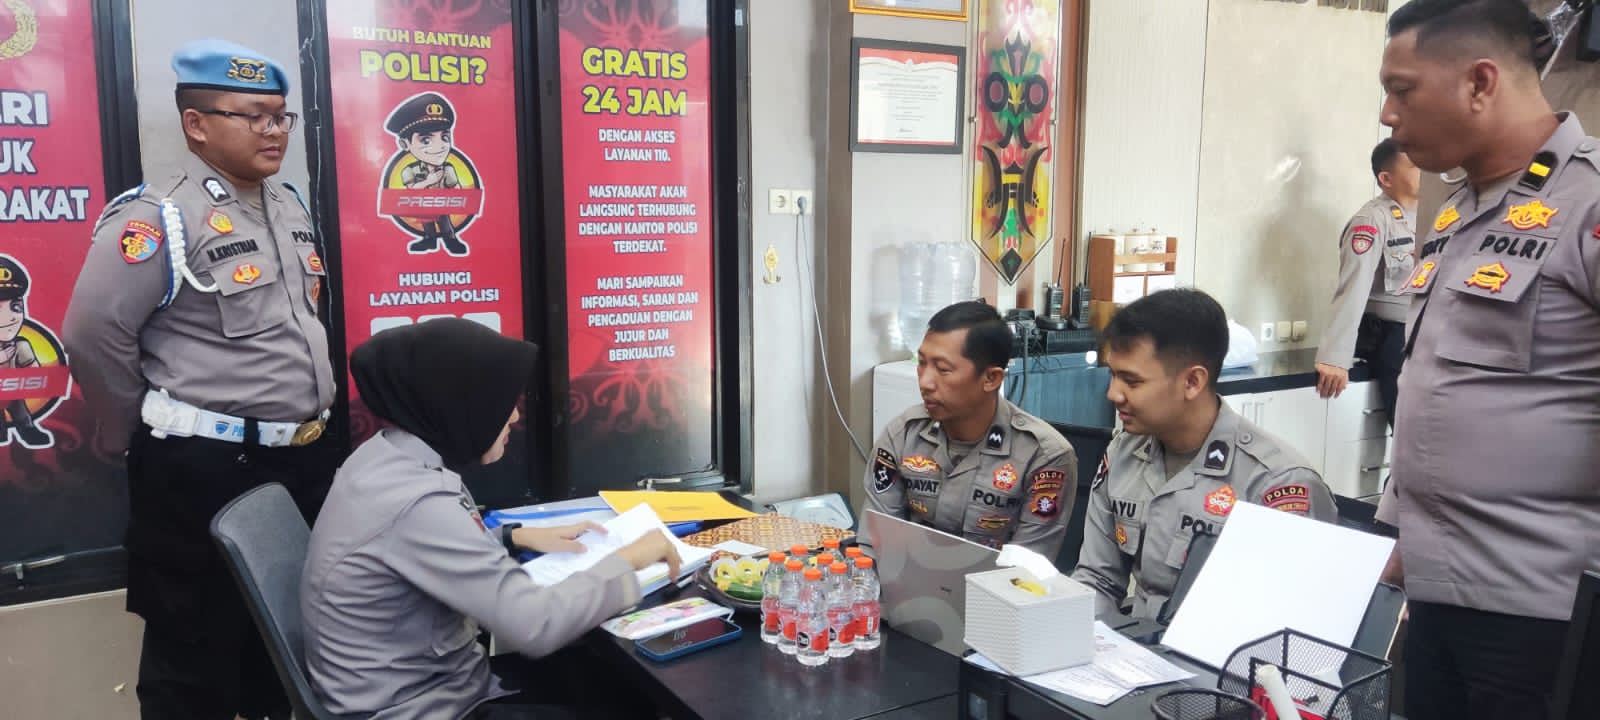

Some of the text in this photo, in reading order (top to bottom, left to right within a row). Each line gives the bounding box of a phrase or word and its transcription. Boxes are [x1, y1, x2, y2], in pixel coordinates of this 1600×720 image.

[353, 27, 491, 48] BUTUH BANTUAN
[360, 51, 487, 84] POLISI?
[583, 47, 688, 79] GRATIS
[0, 91, 48, 125] RI
[583, 86, 687, 116] 24 JAM
[599, 129, 675, 143] DENGAN AKSES
[605, 148, 652, 160] LAYANAN
[589, 185, 687, 198] MASYARAKAT AKAN
[397, 196, 467, 207] PRESISI
[580, 204, 696, 216] LANGSUNG TERHUBUNG
[579, 221, 697, 235] DENGAN KANTOR POLISI
[613, 240, 666, 253] TERDEKAT.
[1479, 234, 1547, 260] POLRI
[399, 271, 471, 286] HUBUNGI
[597, 275, 683, 290] MARI SAMPAIKAN
[369, 289, 499, 306] LAYANAN POLISI
[582, 292, 698, 309] INFORMASI, SARAN DAN
[588, 310, 692, 327] PENGADUAN DENGAN
[615, 328, 668, 343] JUJUR DAN
[609, 345, 675, 361] BERKUALITAS
[0, 376, 48, 391] SISI
[1266, 487, 1304, 502] POLDA
